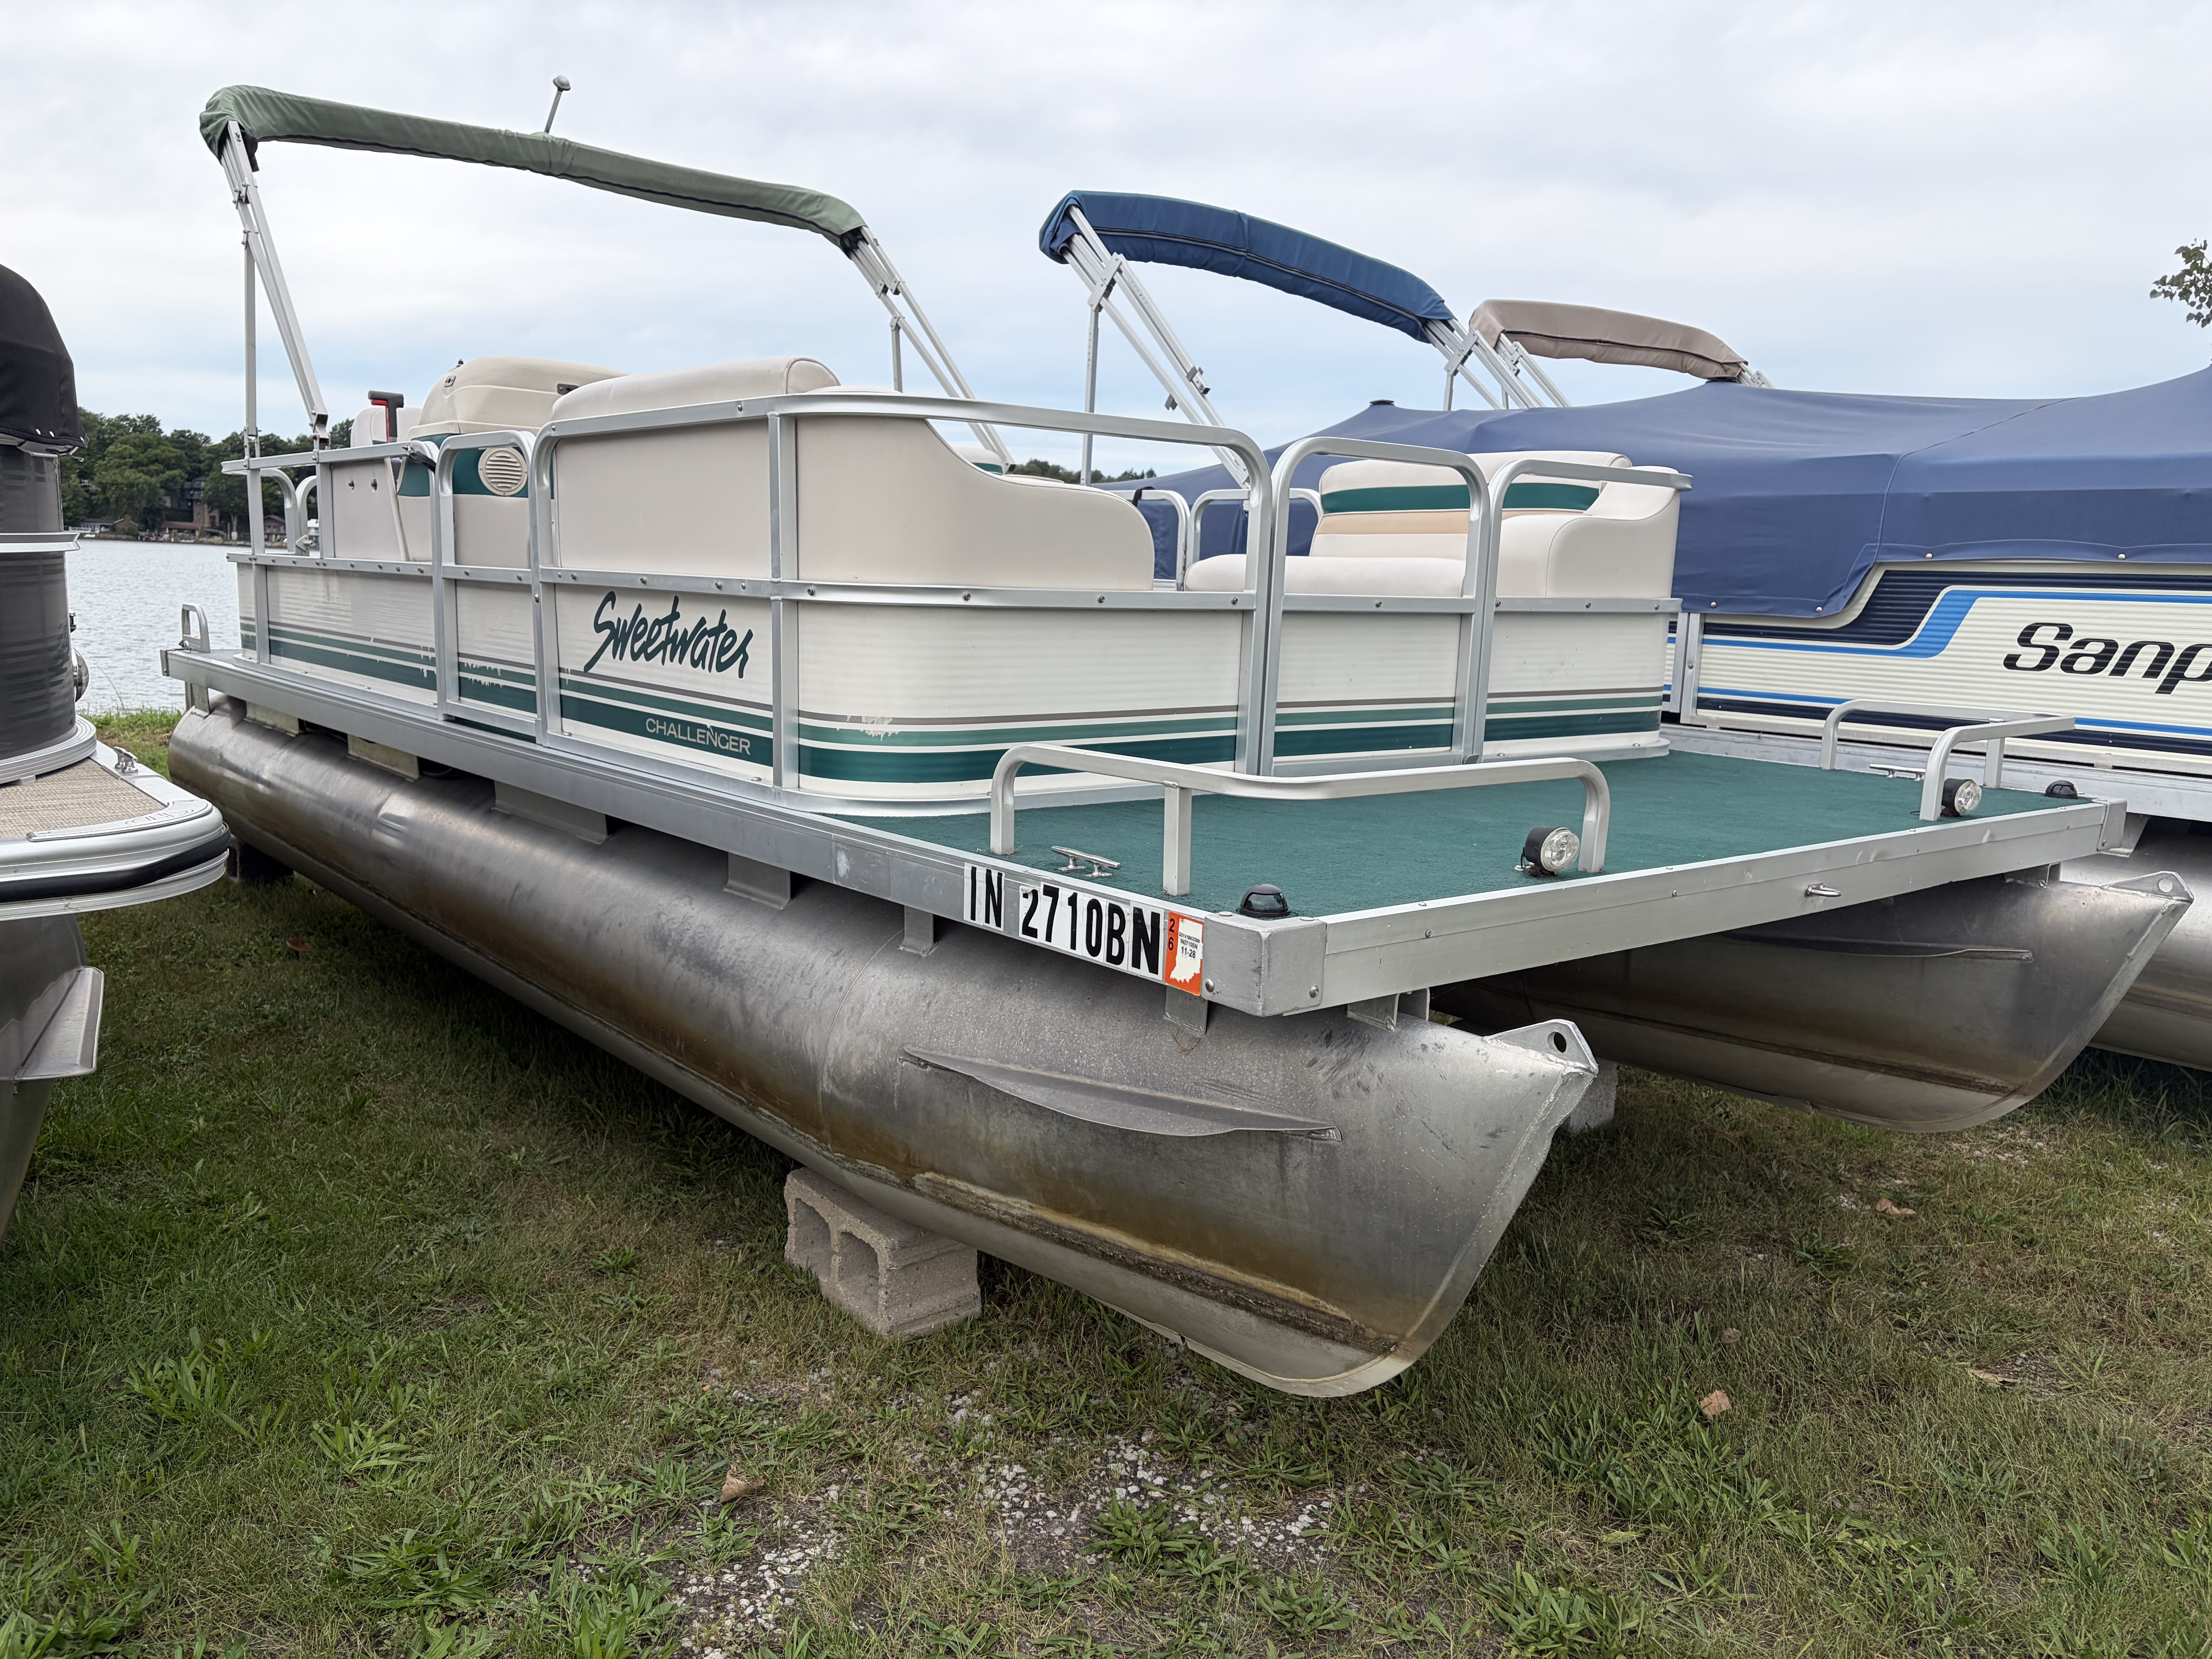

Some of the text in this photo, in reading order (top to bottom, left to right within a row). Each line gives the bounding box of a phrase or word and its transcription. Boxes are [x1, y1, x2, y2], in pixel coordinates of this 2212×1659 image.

[583, 591, 753, 678] Sweetwater
[646, 718, 751, 756] CHALLENGER
[970, 866, 1161, 975] IN 2710BN
[1181, 946, 1196, 958] 11-28
